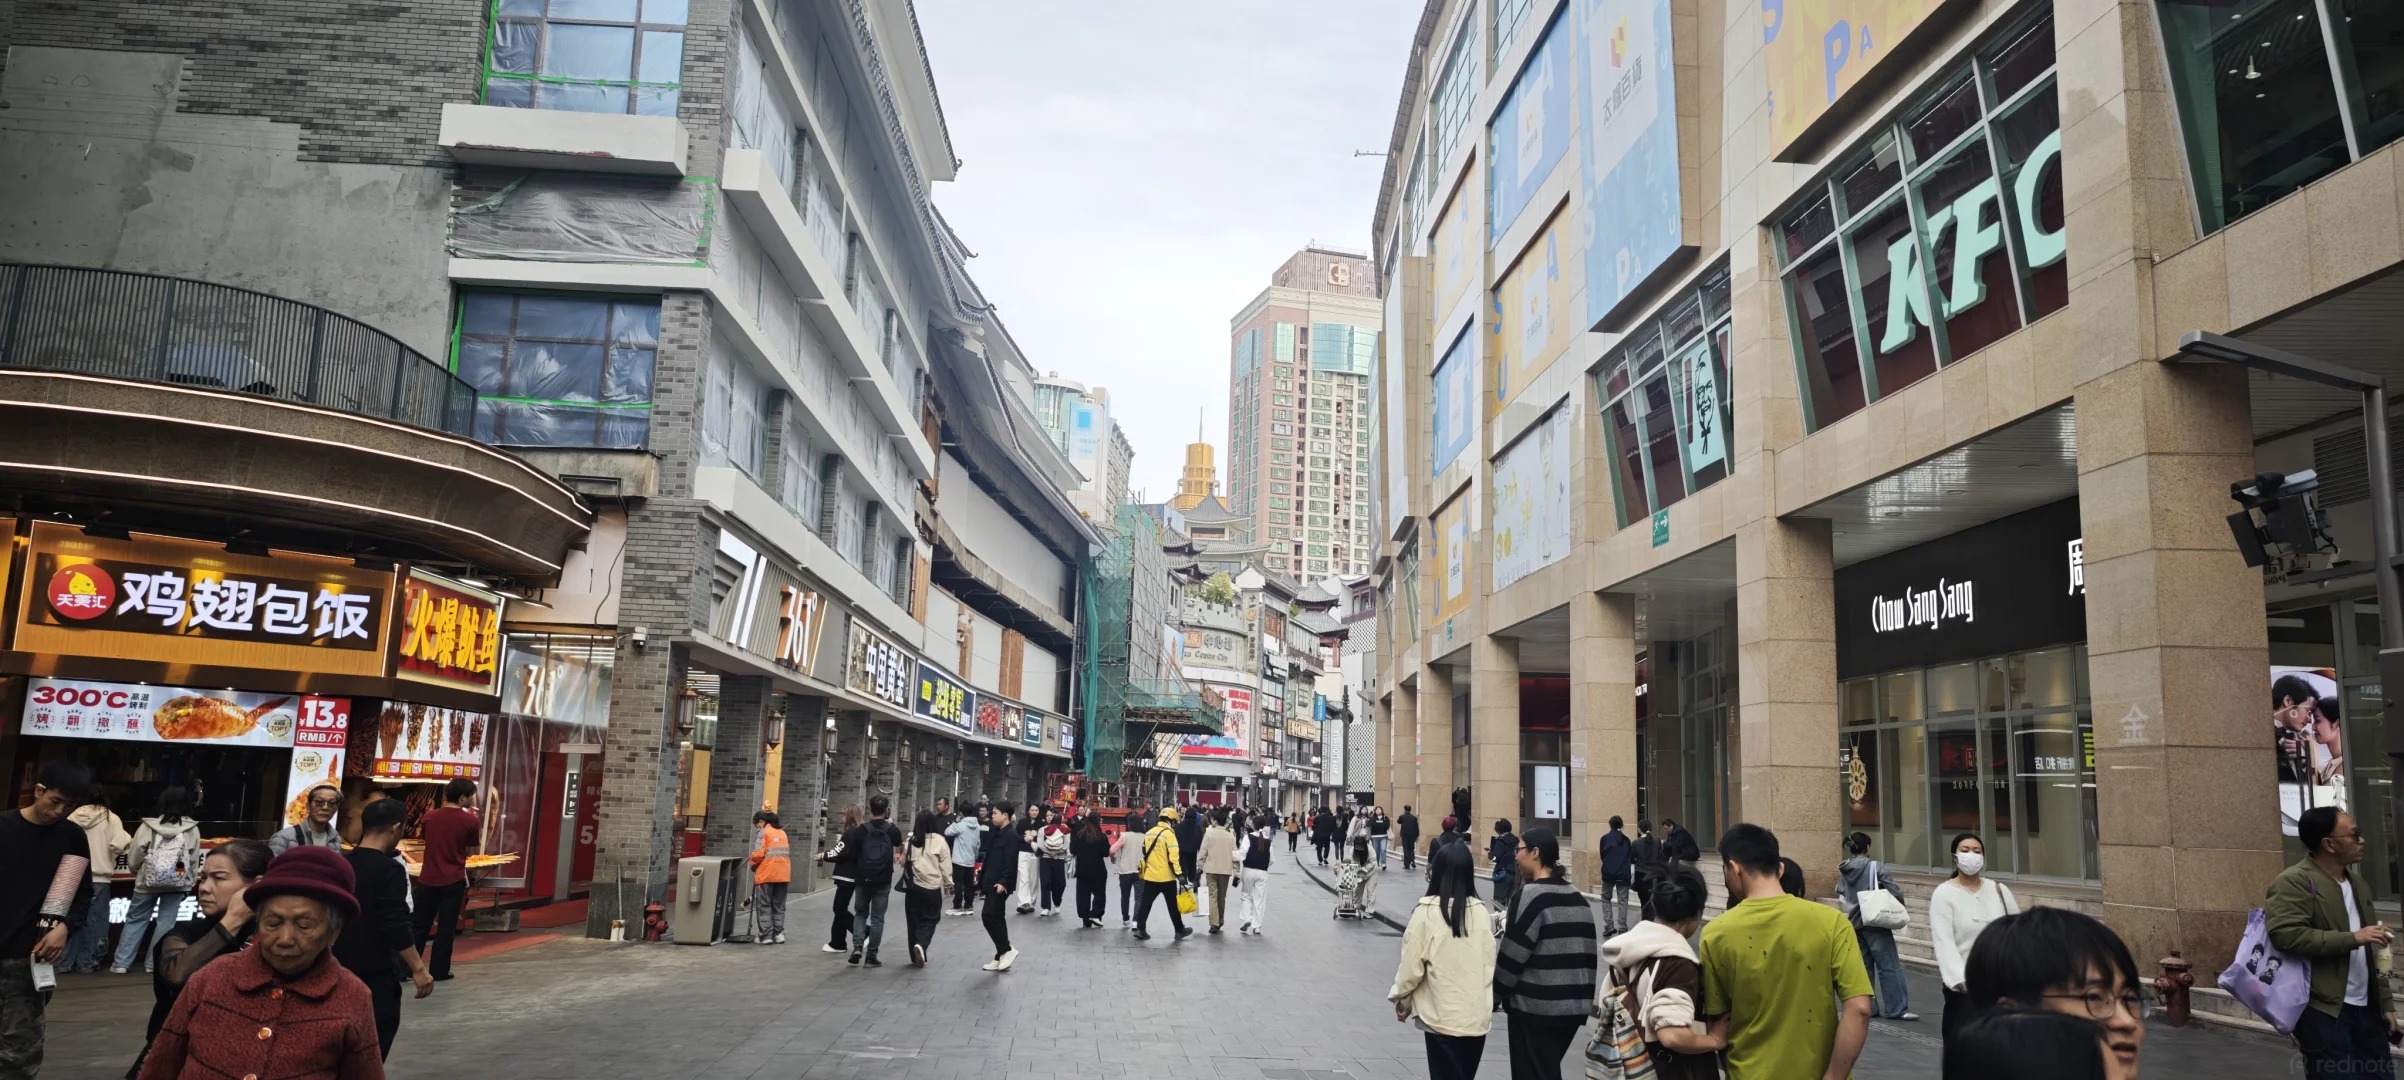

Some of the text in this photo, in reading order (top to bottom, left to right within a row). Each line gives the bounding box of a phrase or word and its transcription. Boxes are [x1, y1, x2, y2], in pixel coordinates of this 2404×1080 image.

[1880, 128, 2067, 355] KFC
[118, 571, 371, 640] 鸡翅包饭
[408, 588, 498, 675] 火爆鱿鱼
[1872, 577, 1974, 633] Chow Sang Sang
[33, 686, 129, 709] 300°C
[130, 692, 150, 702] 高温
[865, 634, 906, 705] 中国黄金
[299, 699, 348, 729] ¥13.8
[299, 732, 343, 743] RMB/个
